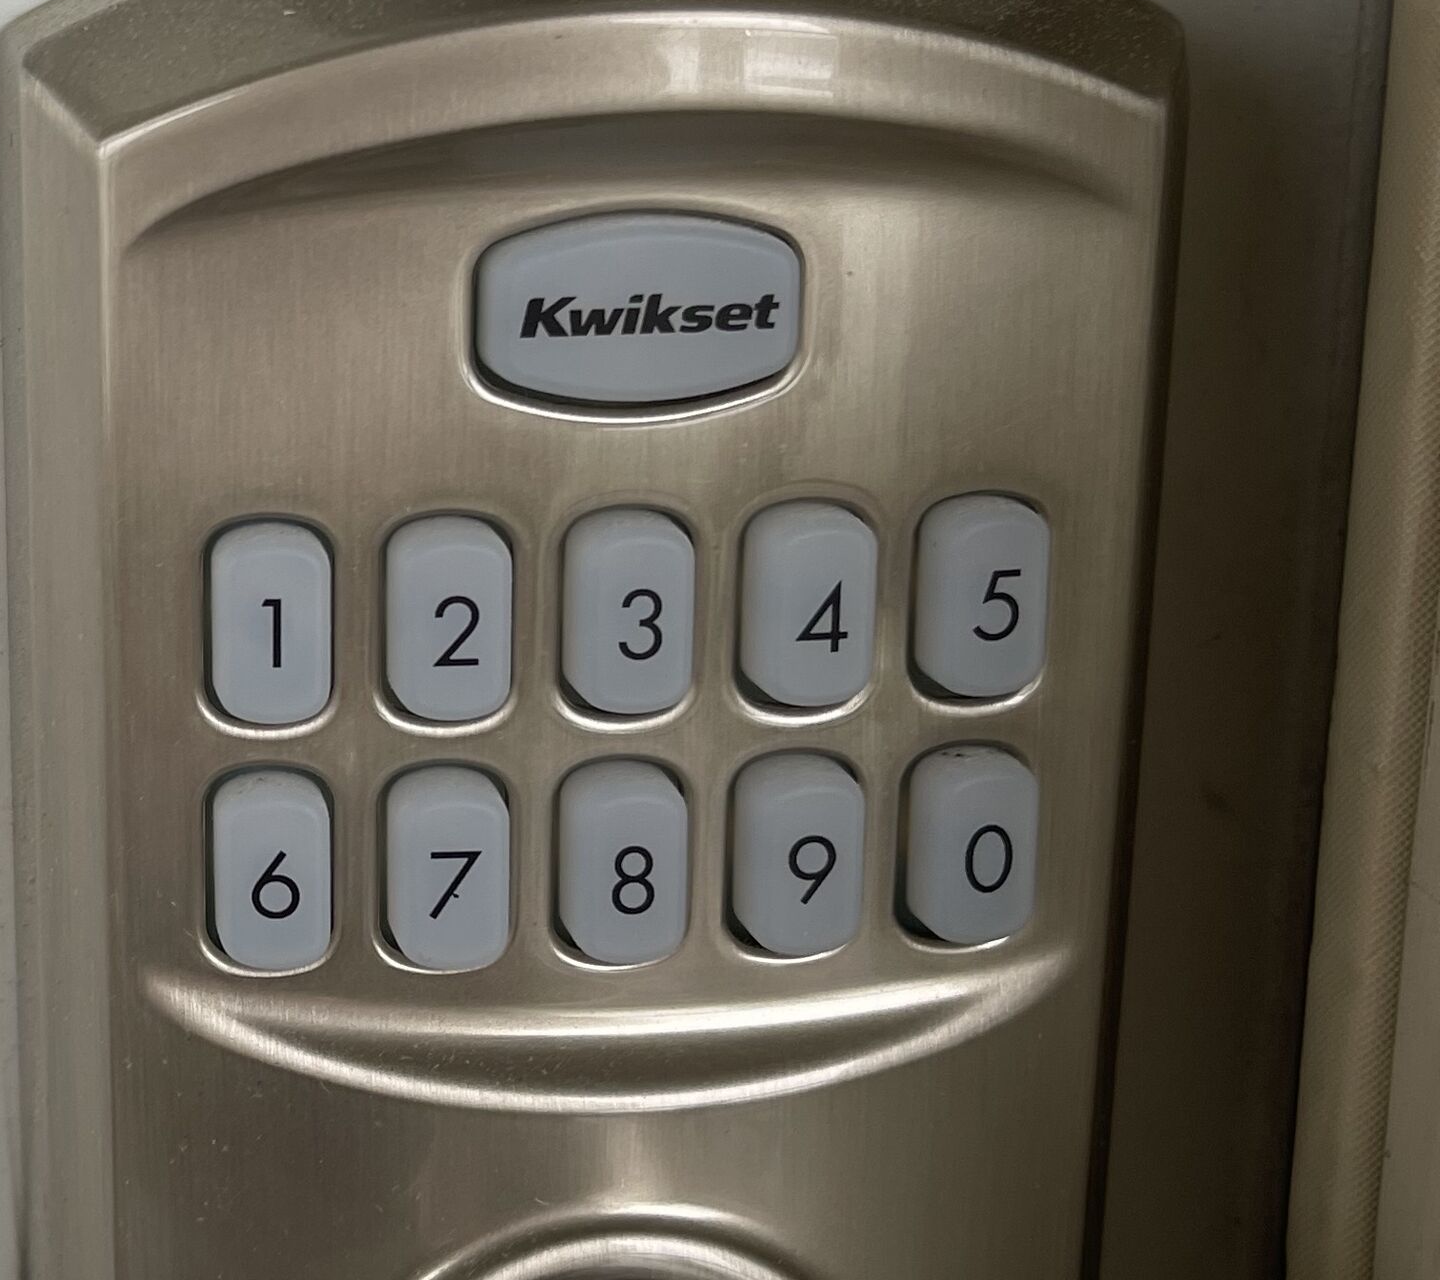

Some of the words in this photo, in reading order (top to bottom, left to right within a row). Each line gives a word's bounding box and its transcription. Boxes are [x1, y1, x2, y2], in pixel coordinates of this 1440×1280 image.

[520, 294, 779, 338] Kwikset
[262, 599, 281, 668] 1
[434, 596, 479, 667] 2
[619, 589, 662, 660] 3
[796, 581, 848, 653] 4
[973, 569, 1021, 641] 5
[252, 851, 300, 919] 6
[430, 851, 482, 919] 7
[612, 846, 655, 914] 8
[789, 835, 836, 904] 9
[965, 825, 1013, 893] 0
